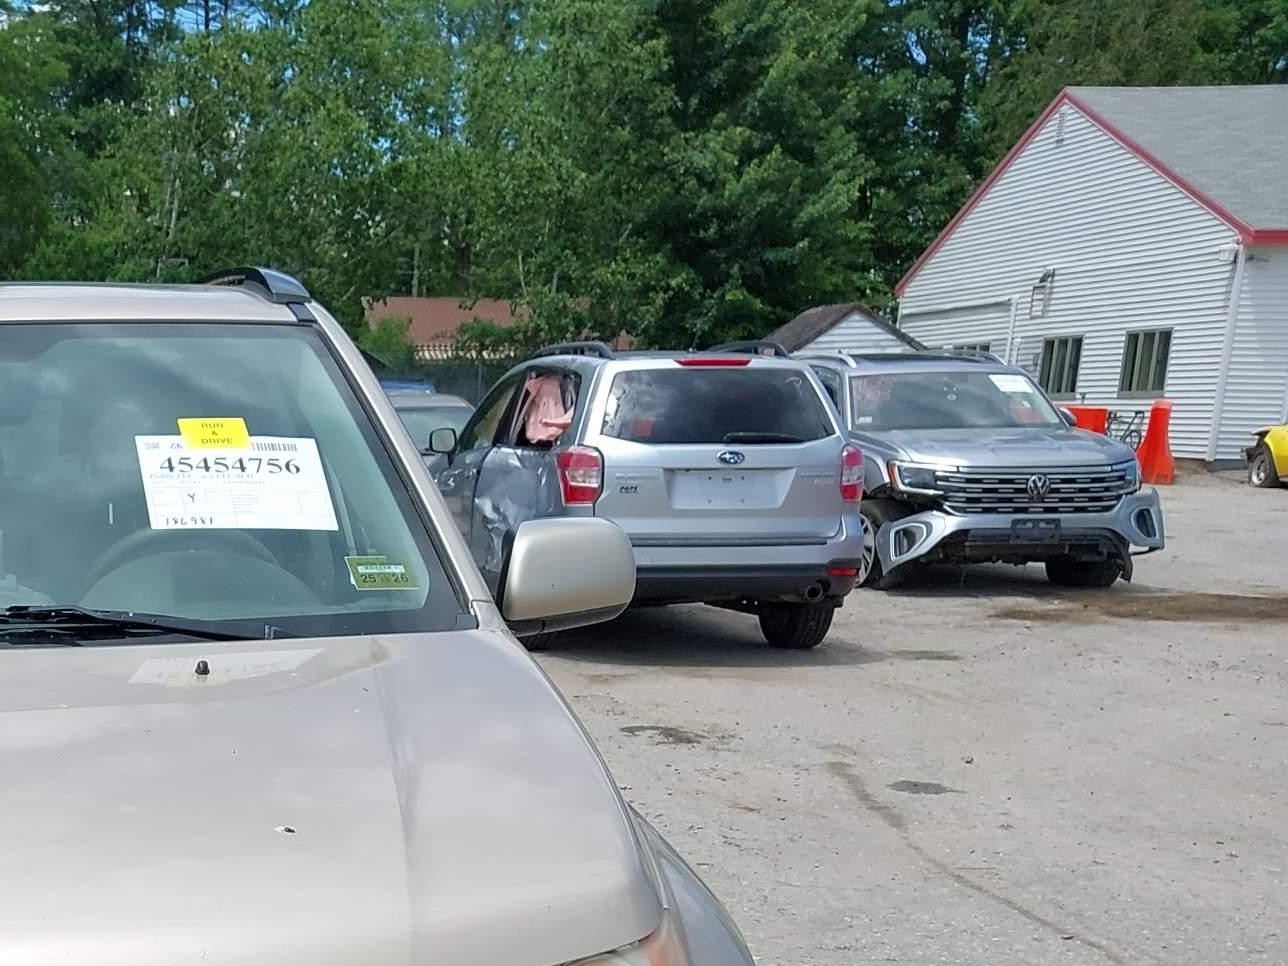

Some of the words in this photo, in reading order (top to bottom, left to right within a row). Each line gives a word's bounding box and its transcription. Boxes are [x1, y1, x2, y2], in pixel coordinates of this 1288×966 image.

[201, 437, 233, 445] DRIVE
[159, 456, 302, 475] 45454756
[360, 574, 377, 583] 25
[392, 573, 409, 583] 26
